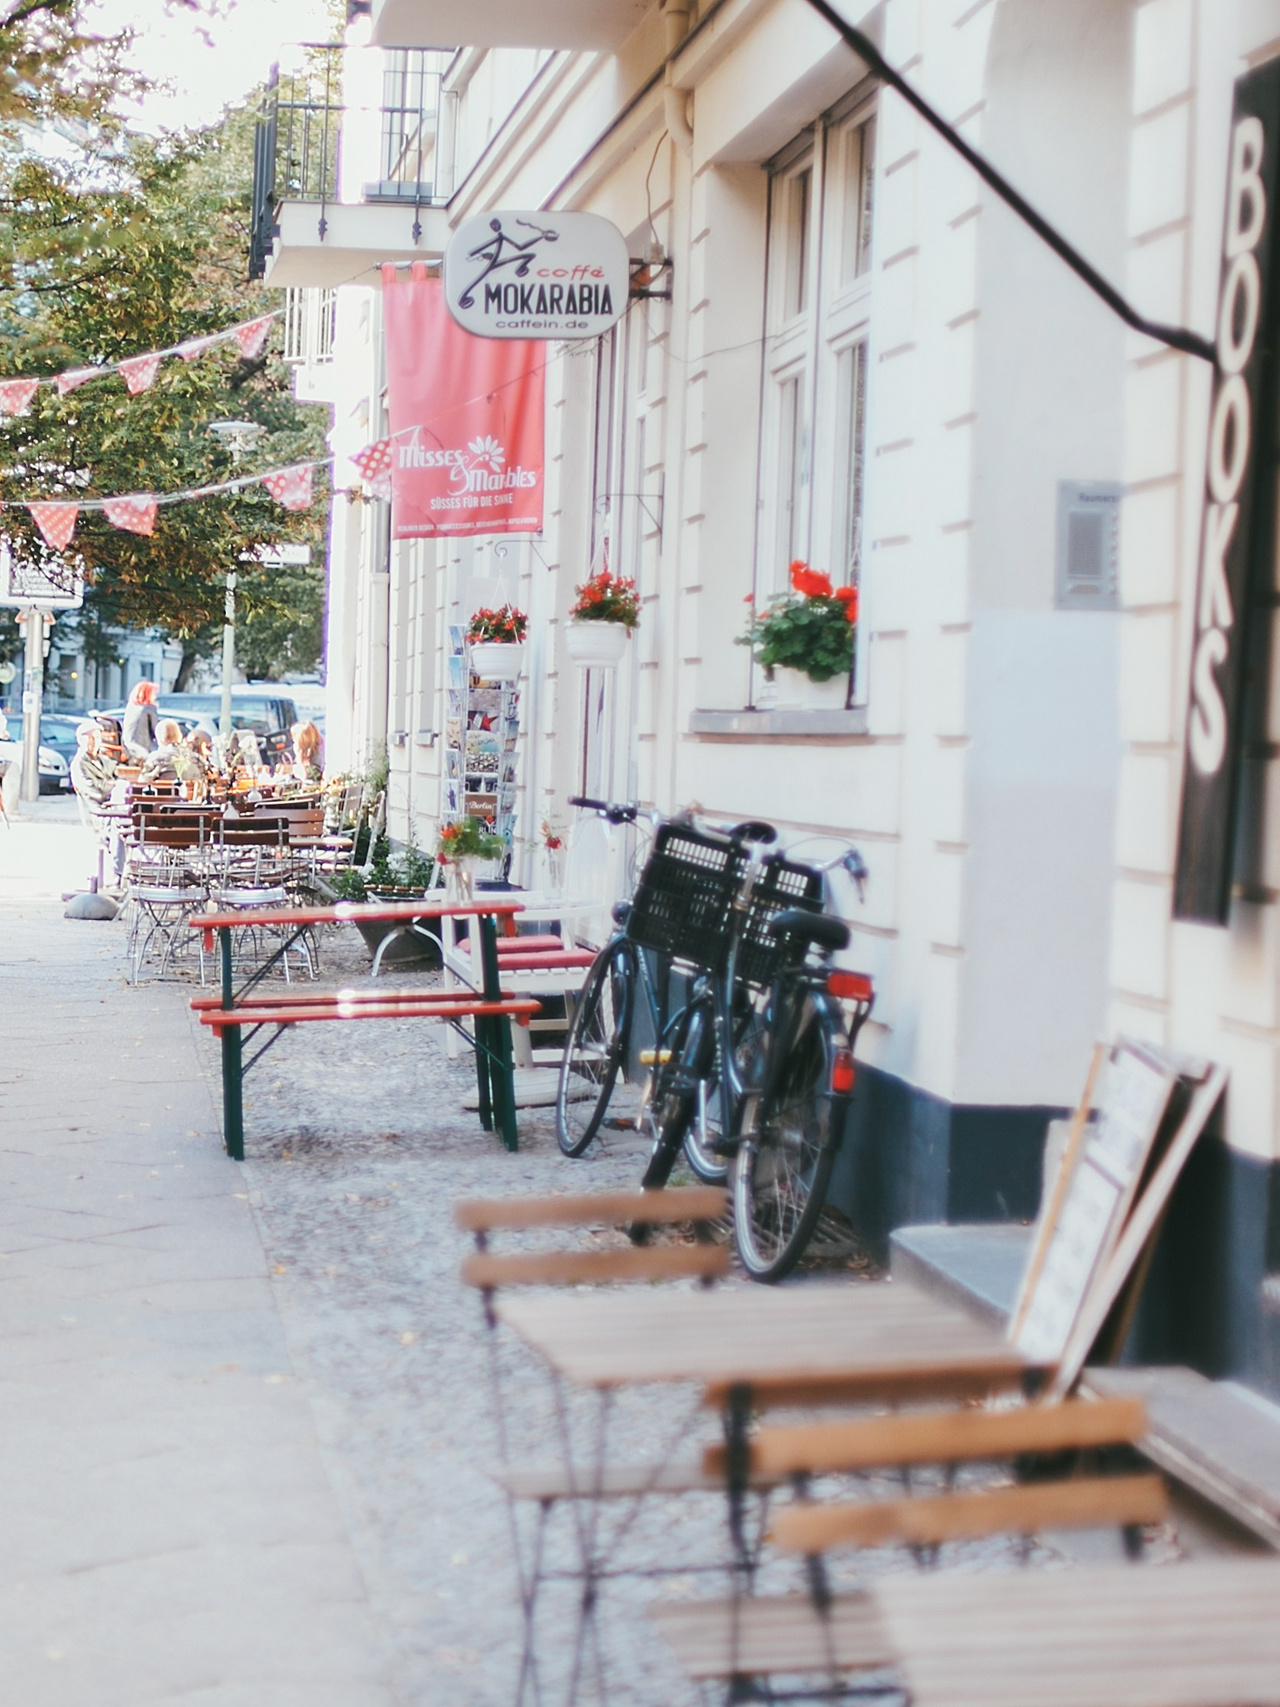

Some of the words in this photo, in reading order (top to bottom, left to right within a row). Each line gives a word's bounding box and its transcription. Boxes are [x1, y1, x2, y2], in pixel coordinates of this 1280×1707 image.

[484, 283, 613, 315] MOKARABIA
[495, 319, 589, 330] caffein.de
[1189, 115, 1266, 775] BOOKS
